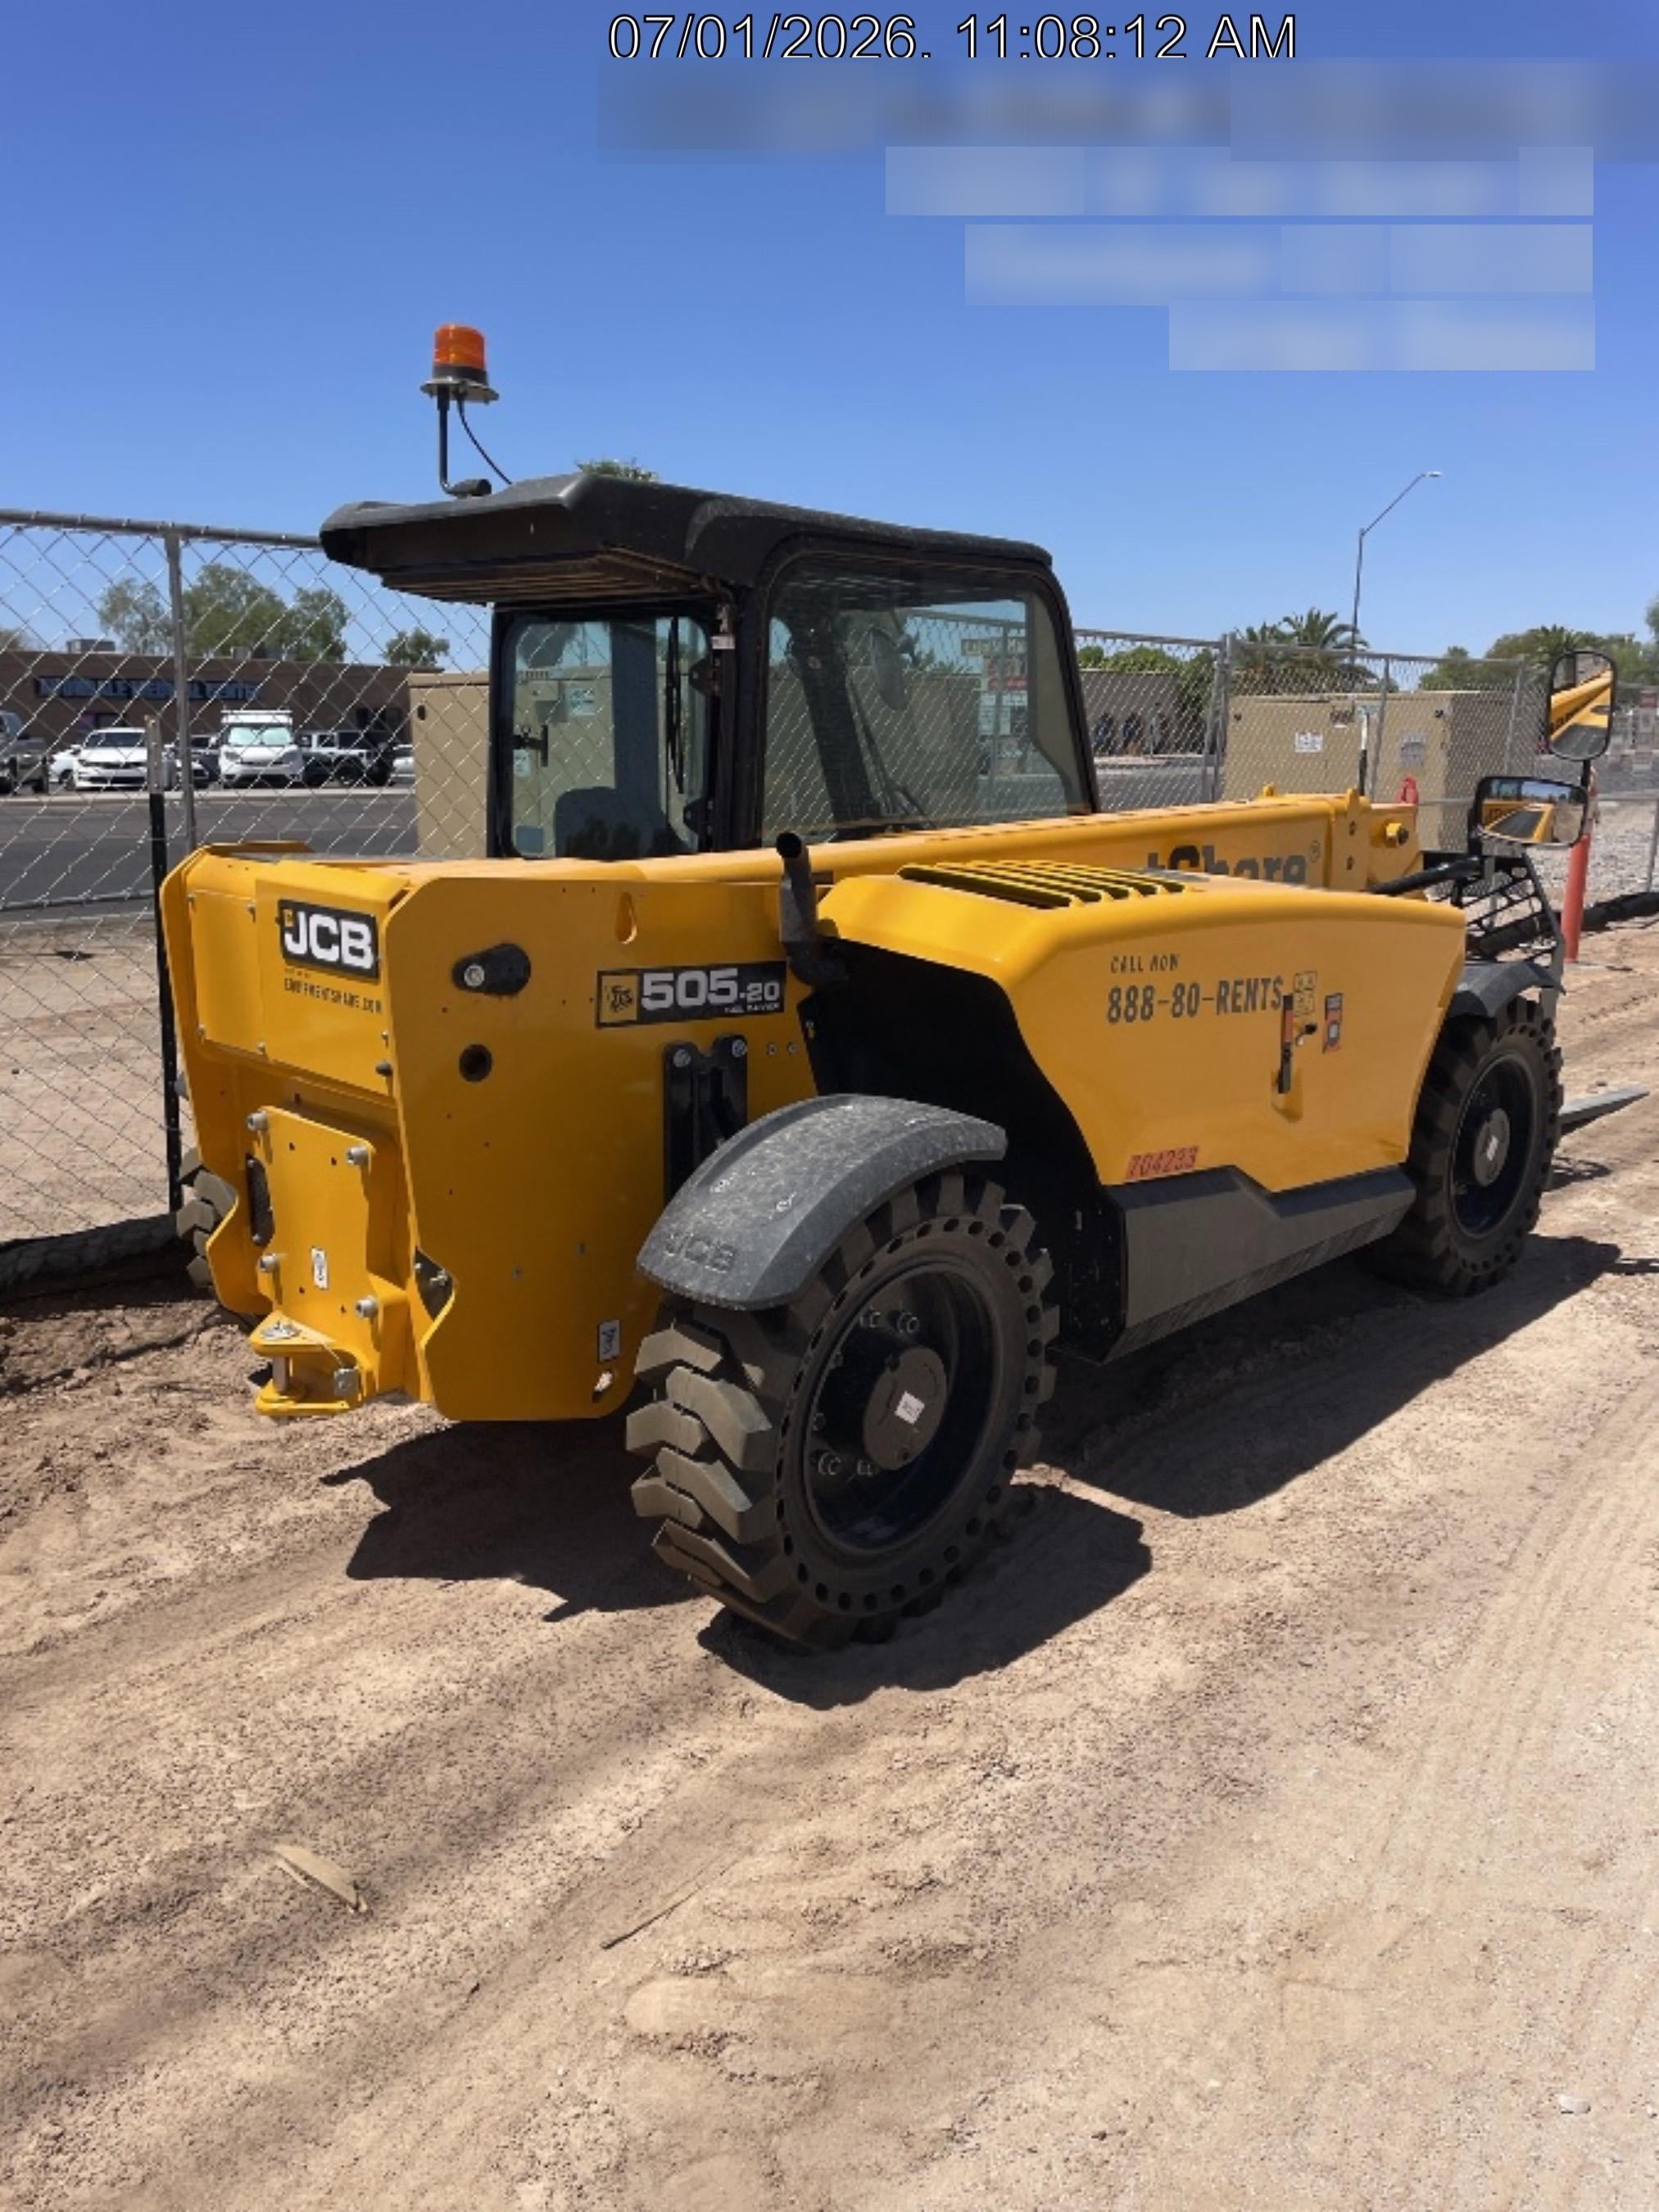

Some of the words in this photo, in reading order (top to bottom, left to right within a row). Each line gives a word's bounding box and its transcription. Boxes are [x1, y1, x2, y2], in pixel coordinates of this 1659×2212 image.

[284, 911, 374, 969] JCB
[1111, 955, 1144, 974] CALL
[1108, 975, 1284, 1023] 888-80-RENTS
